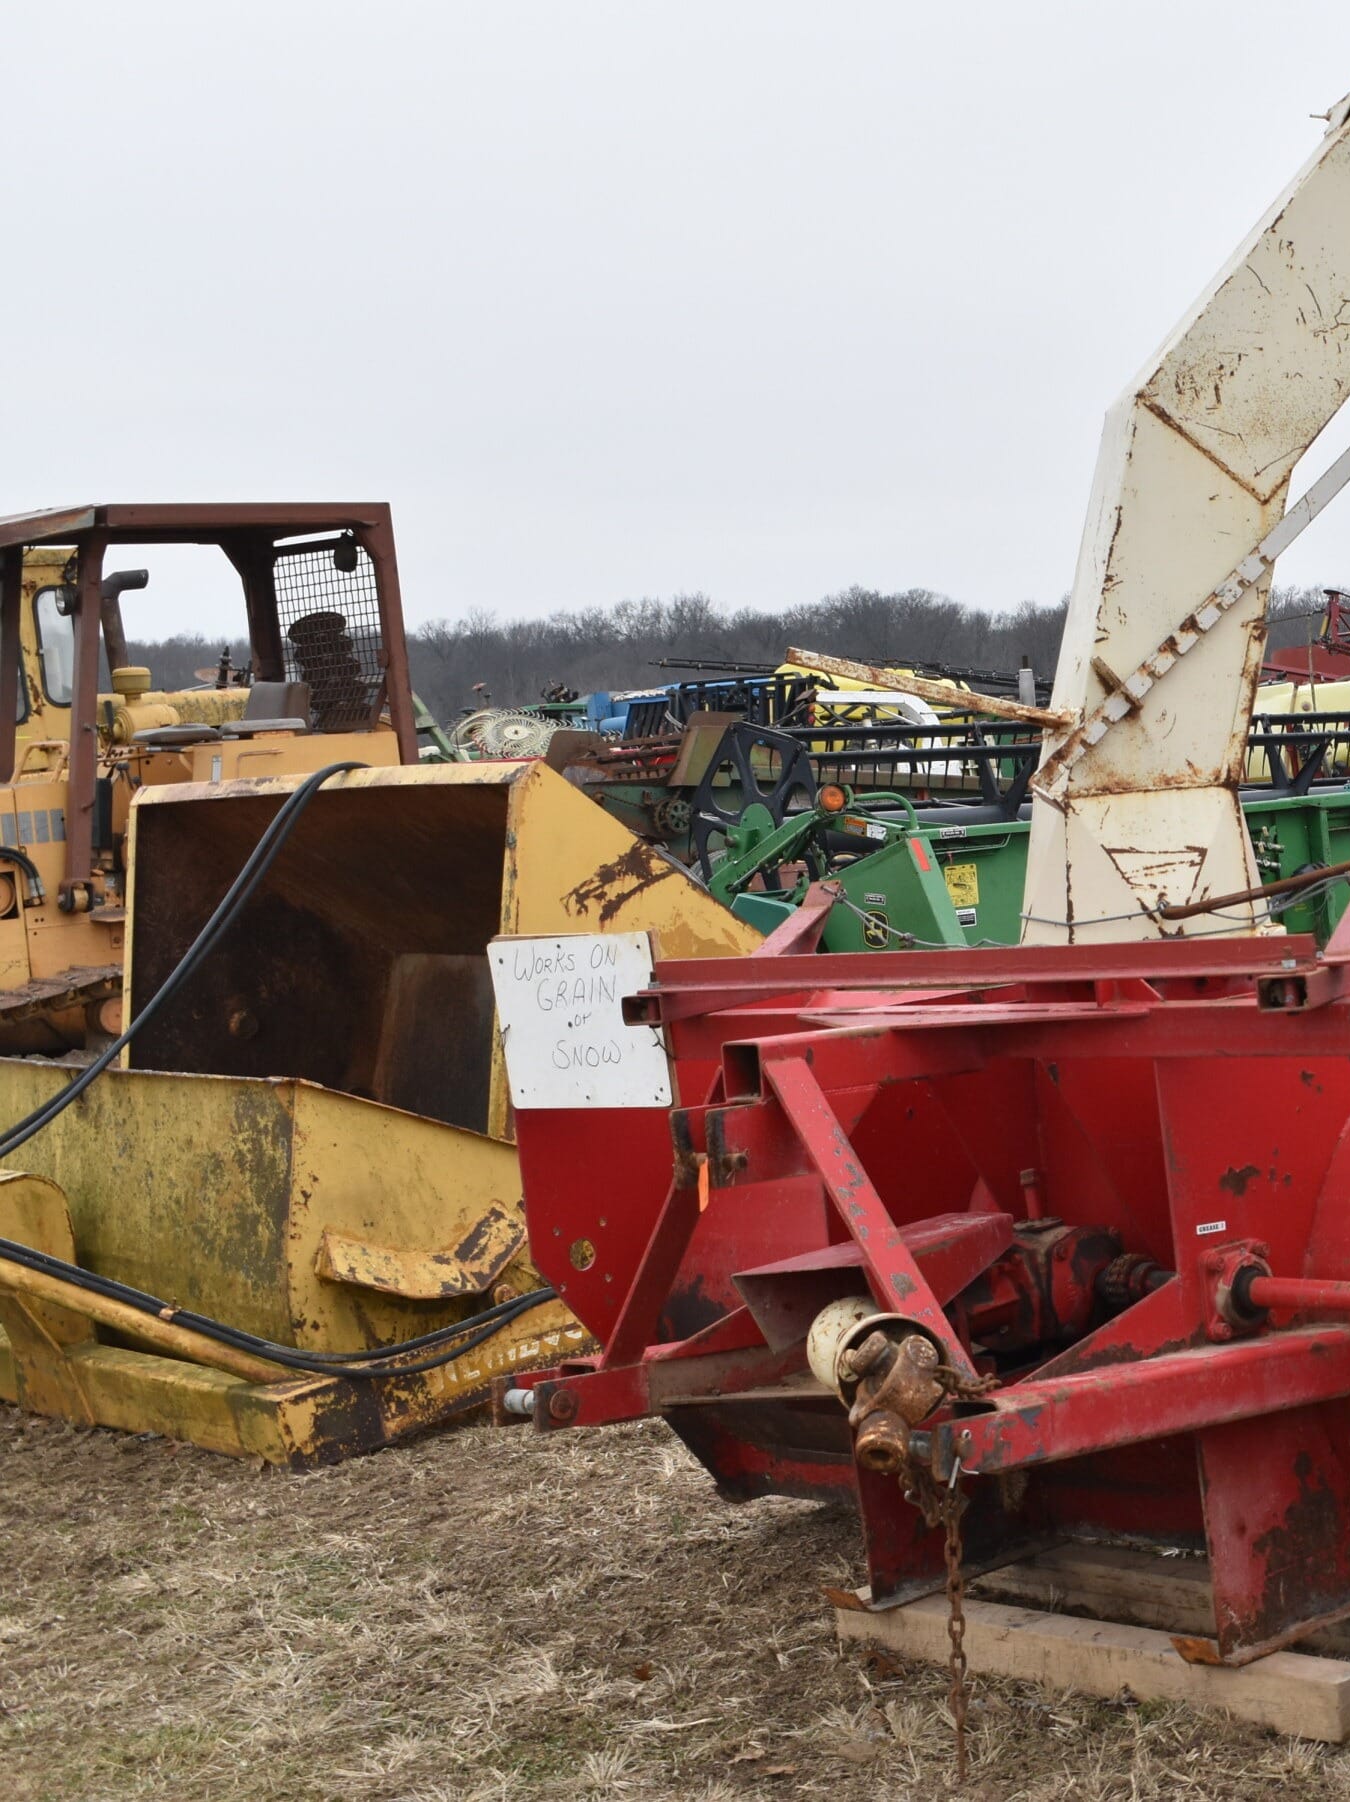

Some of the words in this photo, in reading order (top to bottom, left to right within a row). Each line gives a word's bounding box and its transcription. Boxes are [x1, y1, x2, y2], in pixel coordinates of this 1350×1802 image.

[514, 946, 576, 982] WORKS
[590, 944, 618, 969] ON
[537, 975, 617, 1011] GRAIN
[552, 1040, 622, 1069] SNOW
